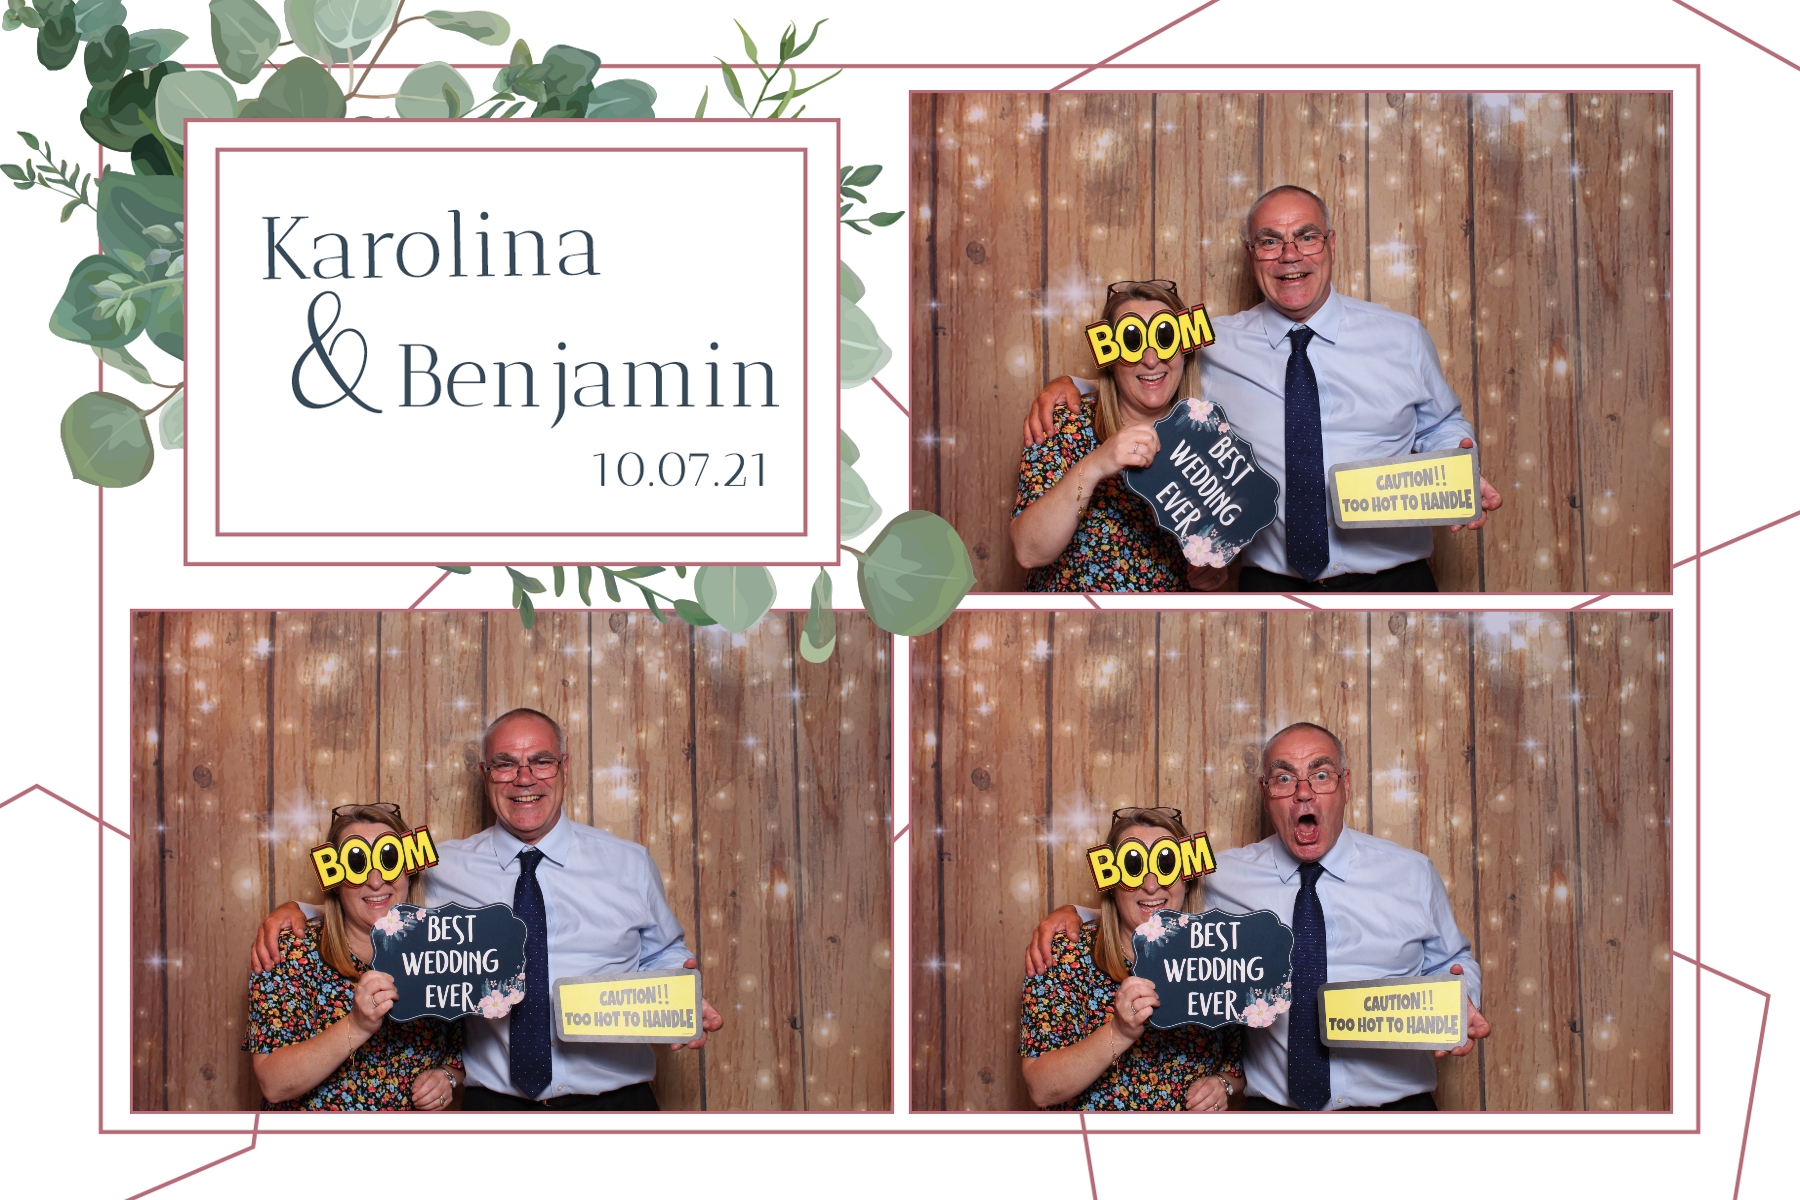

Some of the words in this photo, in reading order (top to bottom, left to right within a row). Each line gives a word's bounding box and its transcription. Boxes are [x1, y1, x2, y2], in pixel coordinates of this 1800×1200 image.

[1085, 303, 1216, 369] BOOM
[1208, 435, 1255, 487] BEST
[1169, 438, 1242, 526] WEDDING
[1376, 464, 1447, 491] CAUTION!!
[1155, 481, 1202, 537] EVER
[1342, 498, 1369, 513] TOO
[1371, 495, 1398, 512] HOT
[1400, 494, 1418, 511] TO
[1420, 489, 1473, 511] HANDLE
[310, 825, 440, 891] BOOM
[1086, 831, 1217, 892] BOOM
[427, 915, 477, 945] BEST
[1190, 921, 1241, 952] BEST
[401, 948, 499, 976] WEDDING
[1163, 956, 1264, 984] WEDDING
[425, 982, 475, 1012] EVER
[600, 984, 669, 1006] CAUTION!!
[1188, 990, 1240, 1020] EVER
[1363, 990, 1434, 1012] CAUTION!!
[565, 1012, 591, 1026] TOO
[594, 1011, 620, 1027] HOT
[623, 1011, 640, 1027] TO
[643, 1009, 694, 1028] HANDLE
[1329, 1017, 1355, 1031] TOO
[1358, 1016, 1384, 1033] HOT
[1386, 1016, 1404, 1033] TO
[1406, 1014, 1459, 1035] HANDLE
